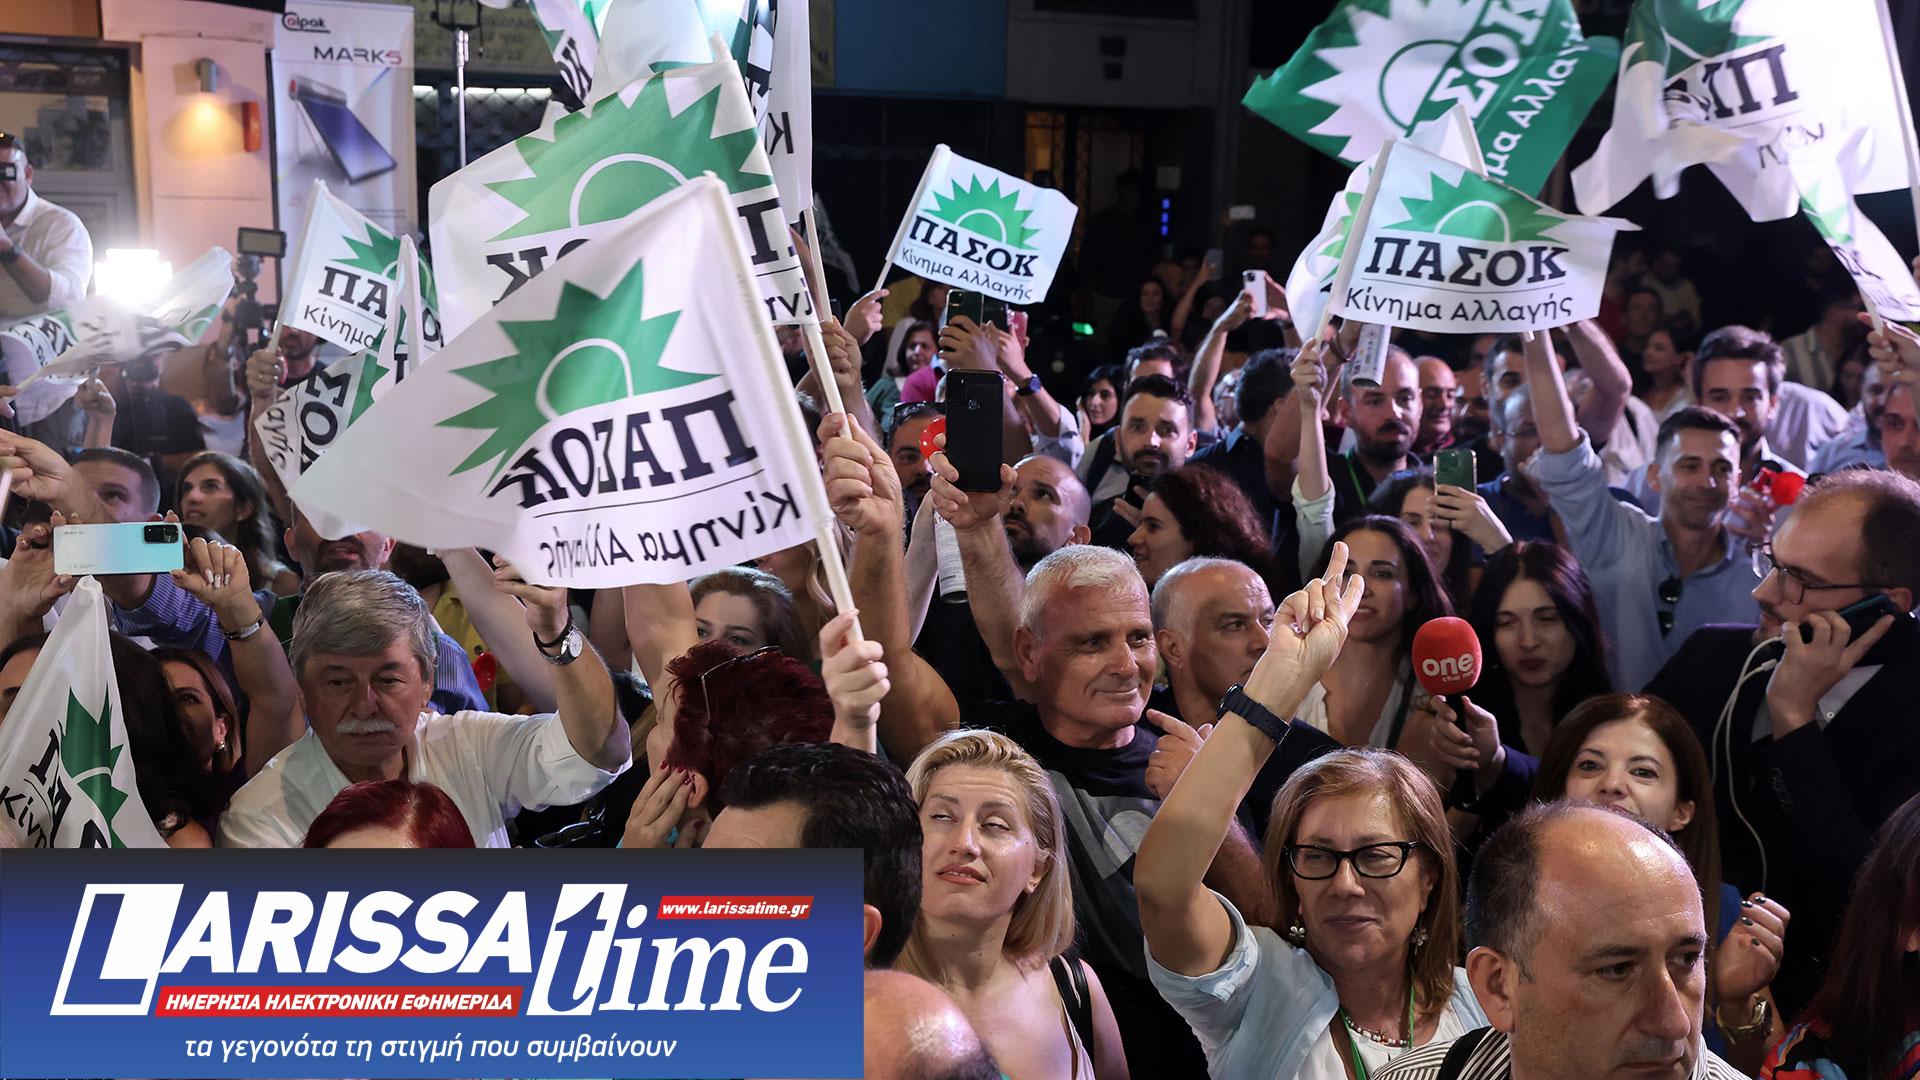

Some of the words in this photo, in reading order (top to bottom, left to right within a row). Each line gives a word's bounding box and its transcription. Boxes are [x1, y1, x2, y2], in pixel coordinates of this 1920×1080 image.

[1430, 0, 1552, 119] ΣΟΚ
[909, 215, 1038, 277] ΠΑΣΟΚ
[1365, 236, 1570, 287] ΠΑΣΟΚ
[902, 247, 953, 277] Κίνημα
[957, 267, 1033, 300] Αλλαγής
[1345, 285, 1442, 321] Κίνημα
[1451, 292, 1573, 324] Αλλαγής
[1422, 653, 1474, 677] one
